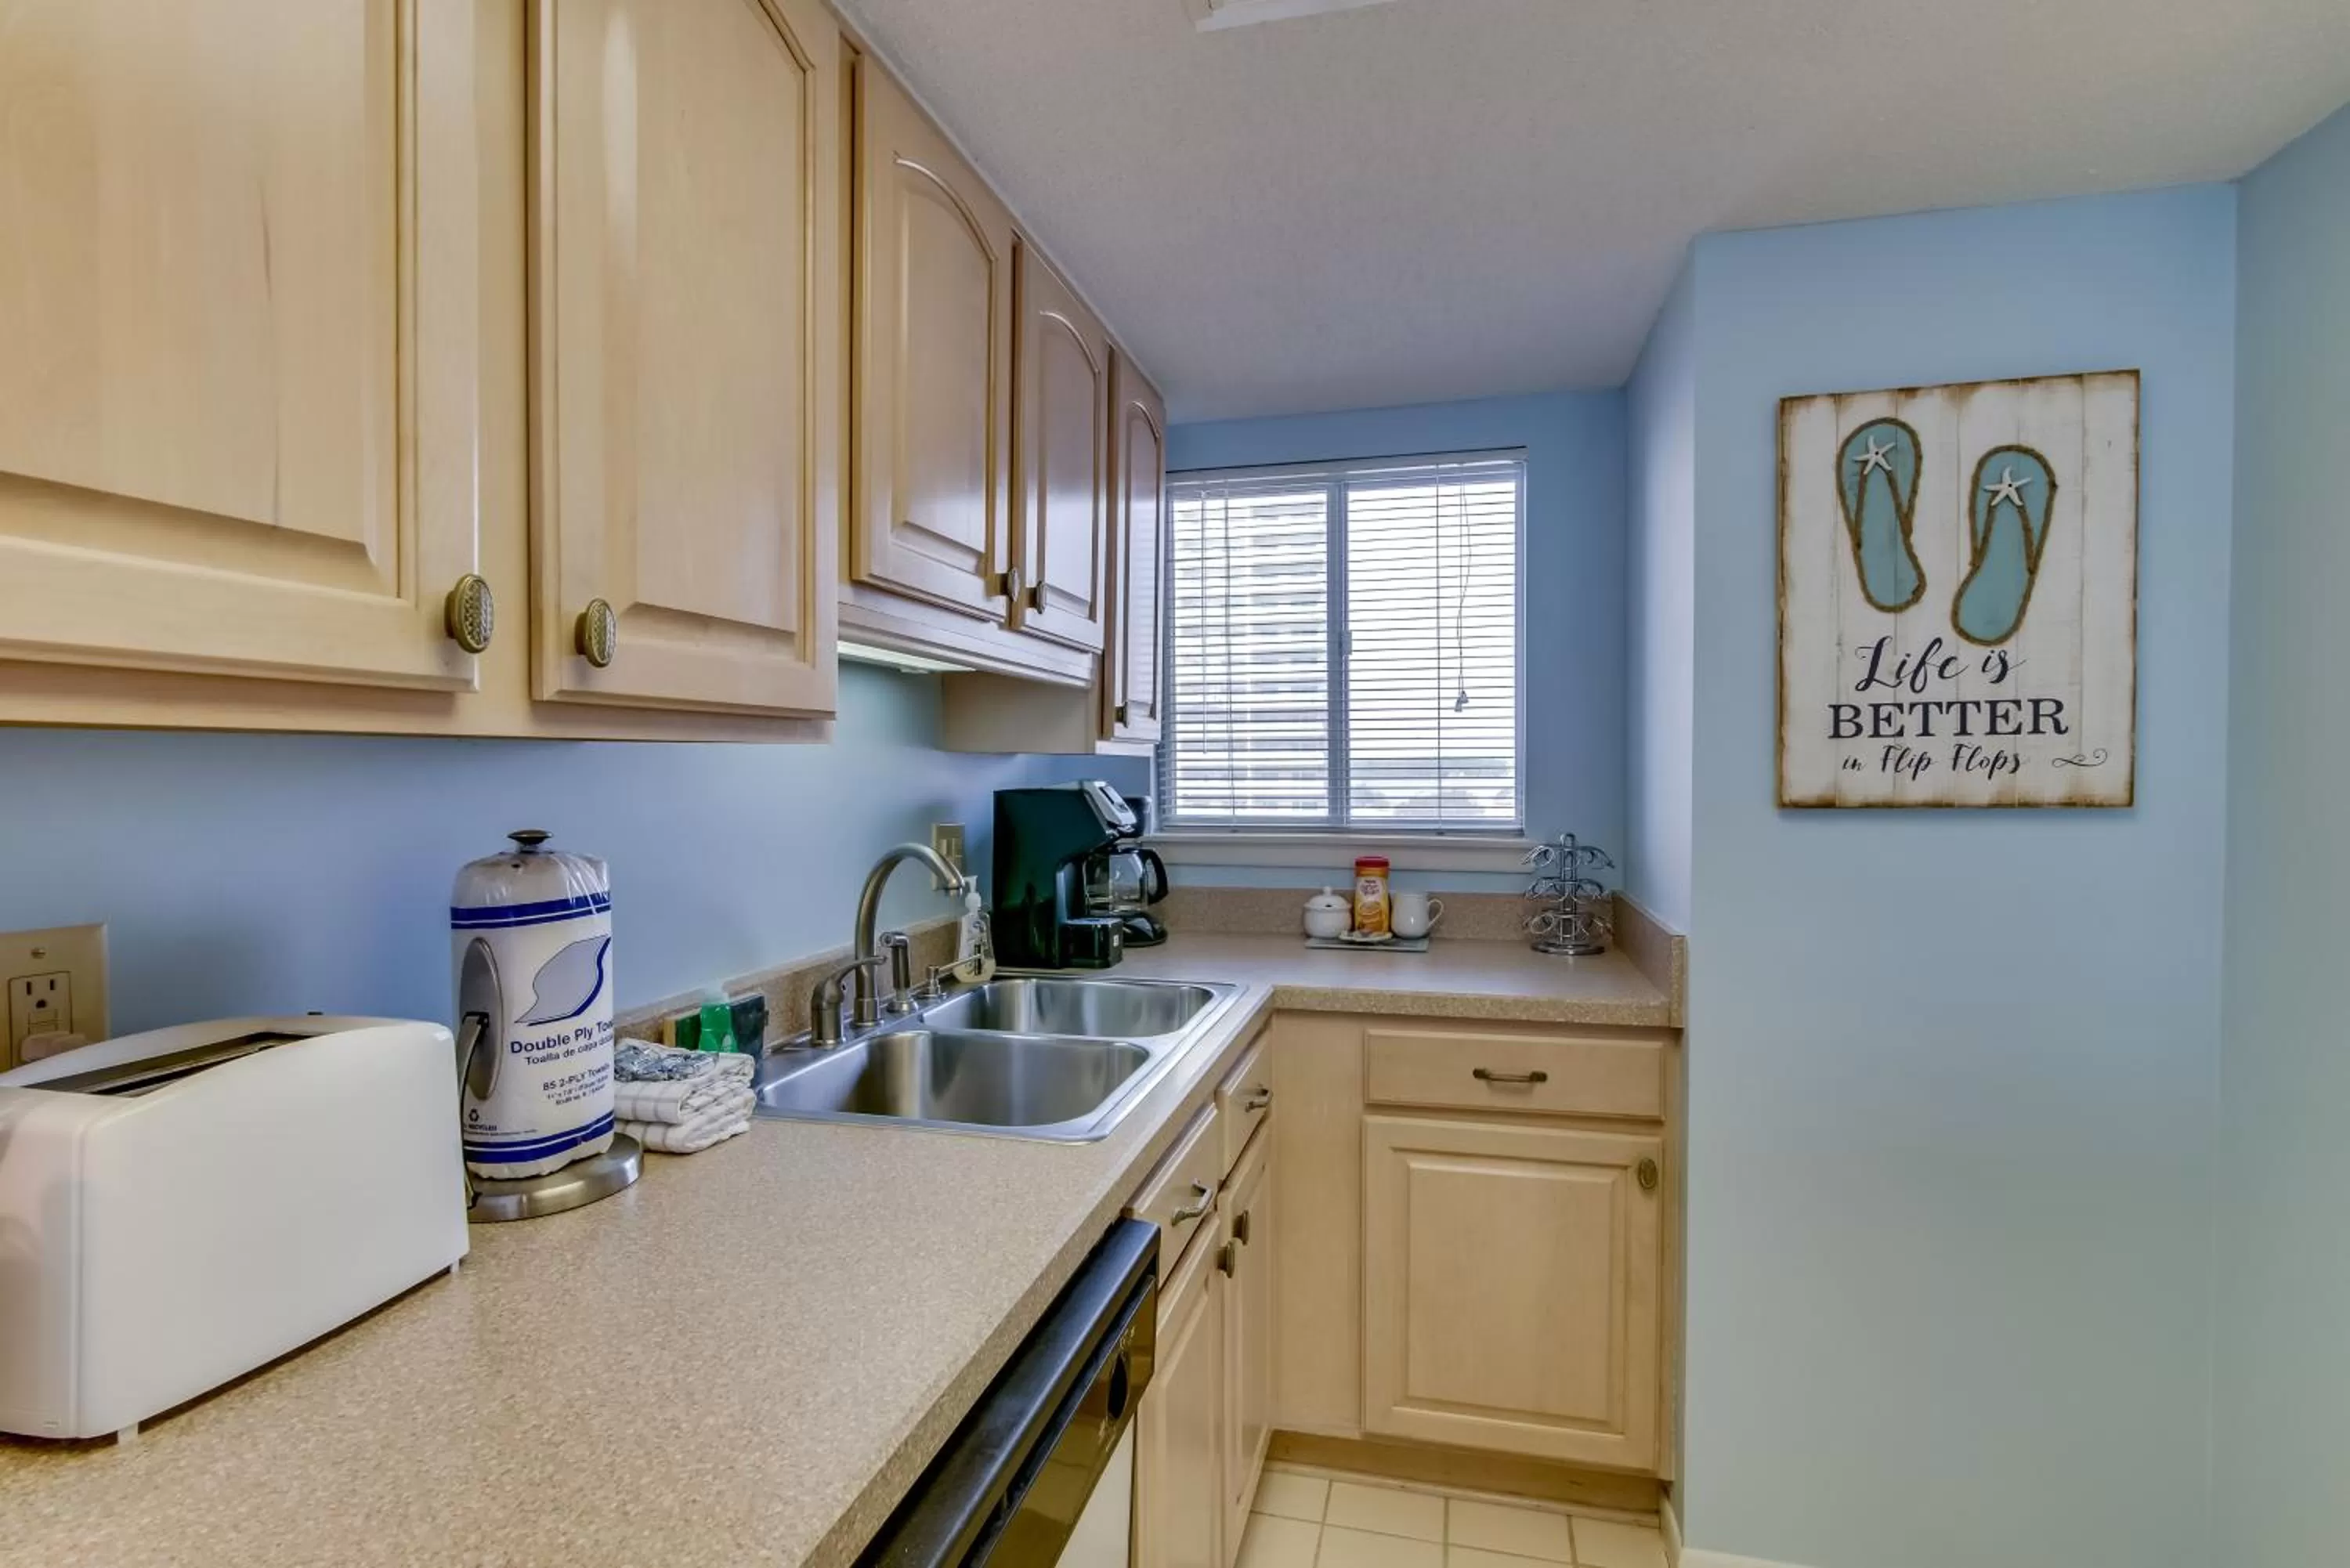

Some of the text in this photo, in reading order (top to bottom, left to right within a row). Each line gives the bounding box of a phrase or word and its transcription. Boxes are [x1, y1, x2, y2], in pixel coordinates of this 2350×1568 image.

[1855, 635, 2026, 693] Life is
[1828, 697, 2069, 739] BETTER
[1842, 742, 2024, 781] in Flip Flops
[510, 1034, 571, 1053] Double
[574, 1027, 593, 1040] Ply
[563, 1048, 575, 1057] de
